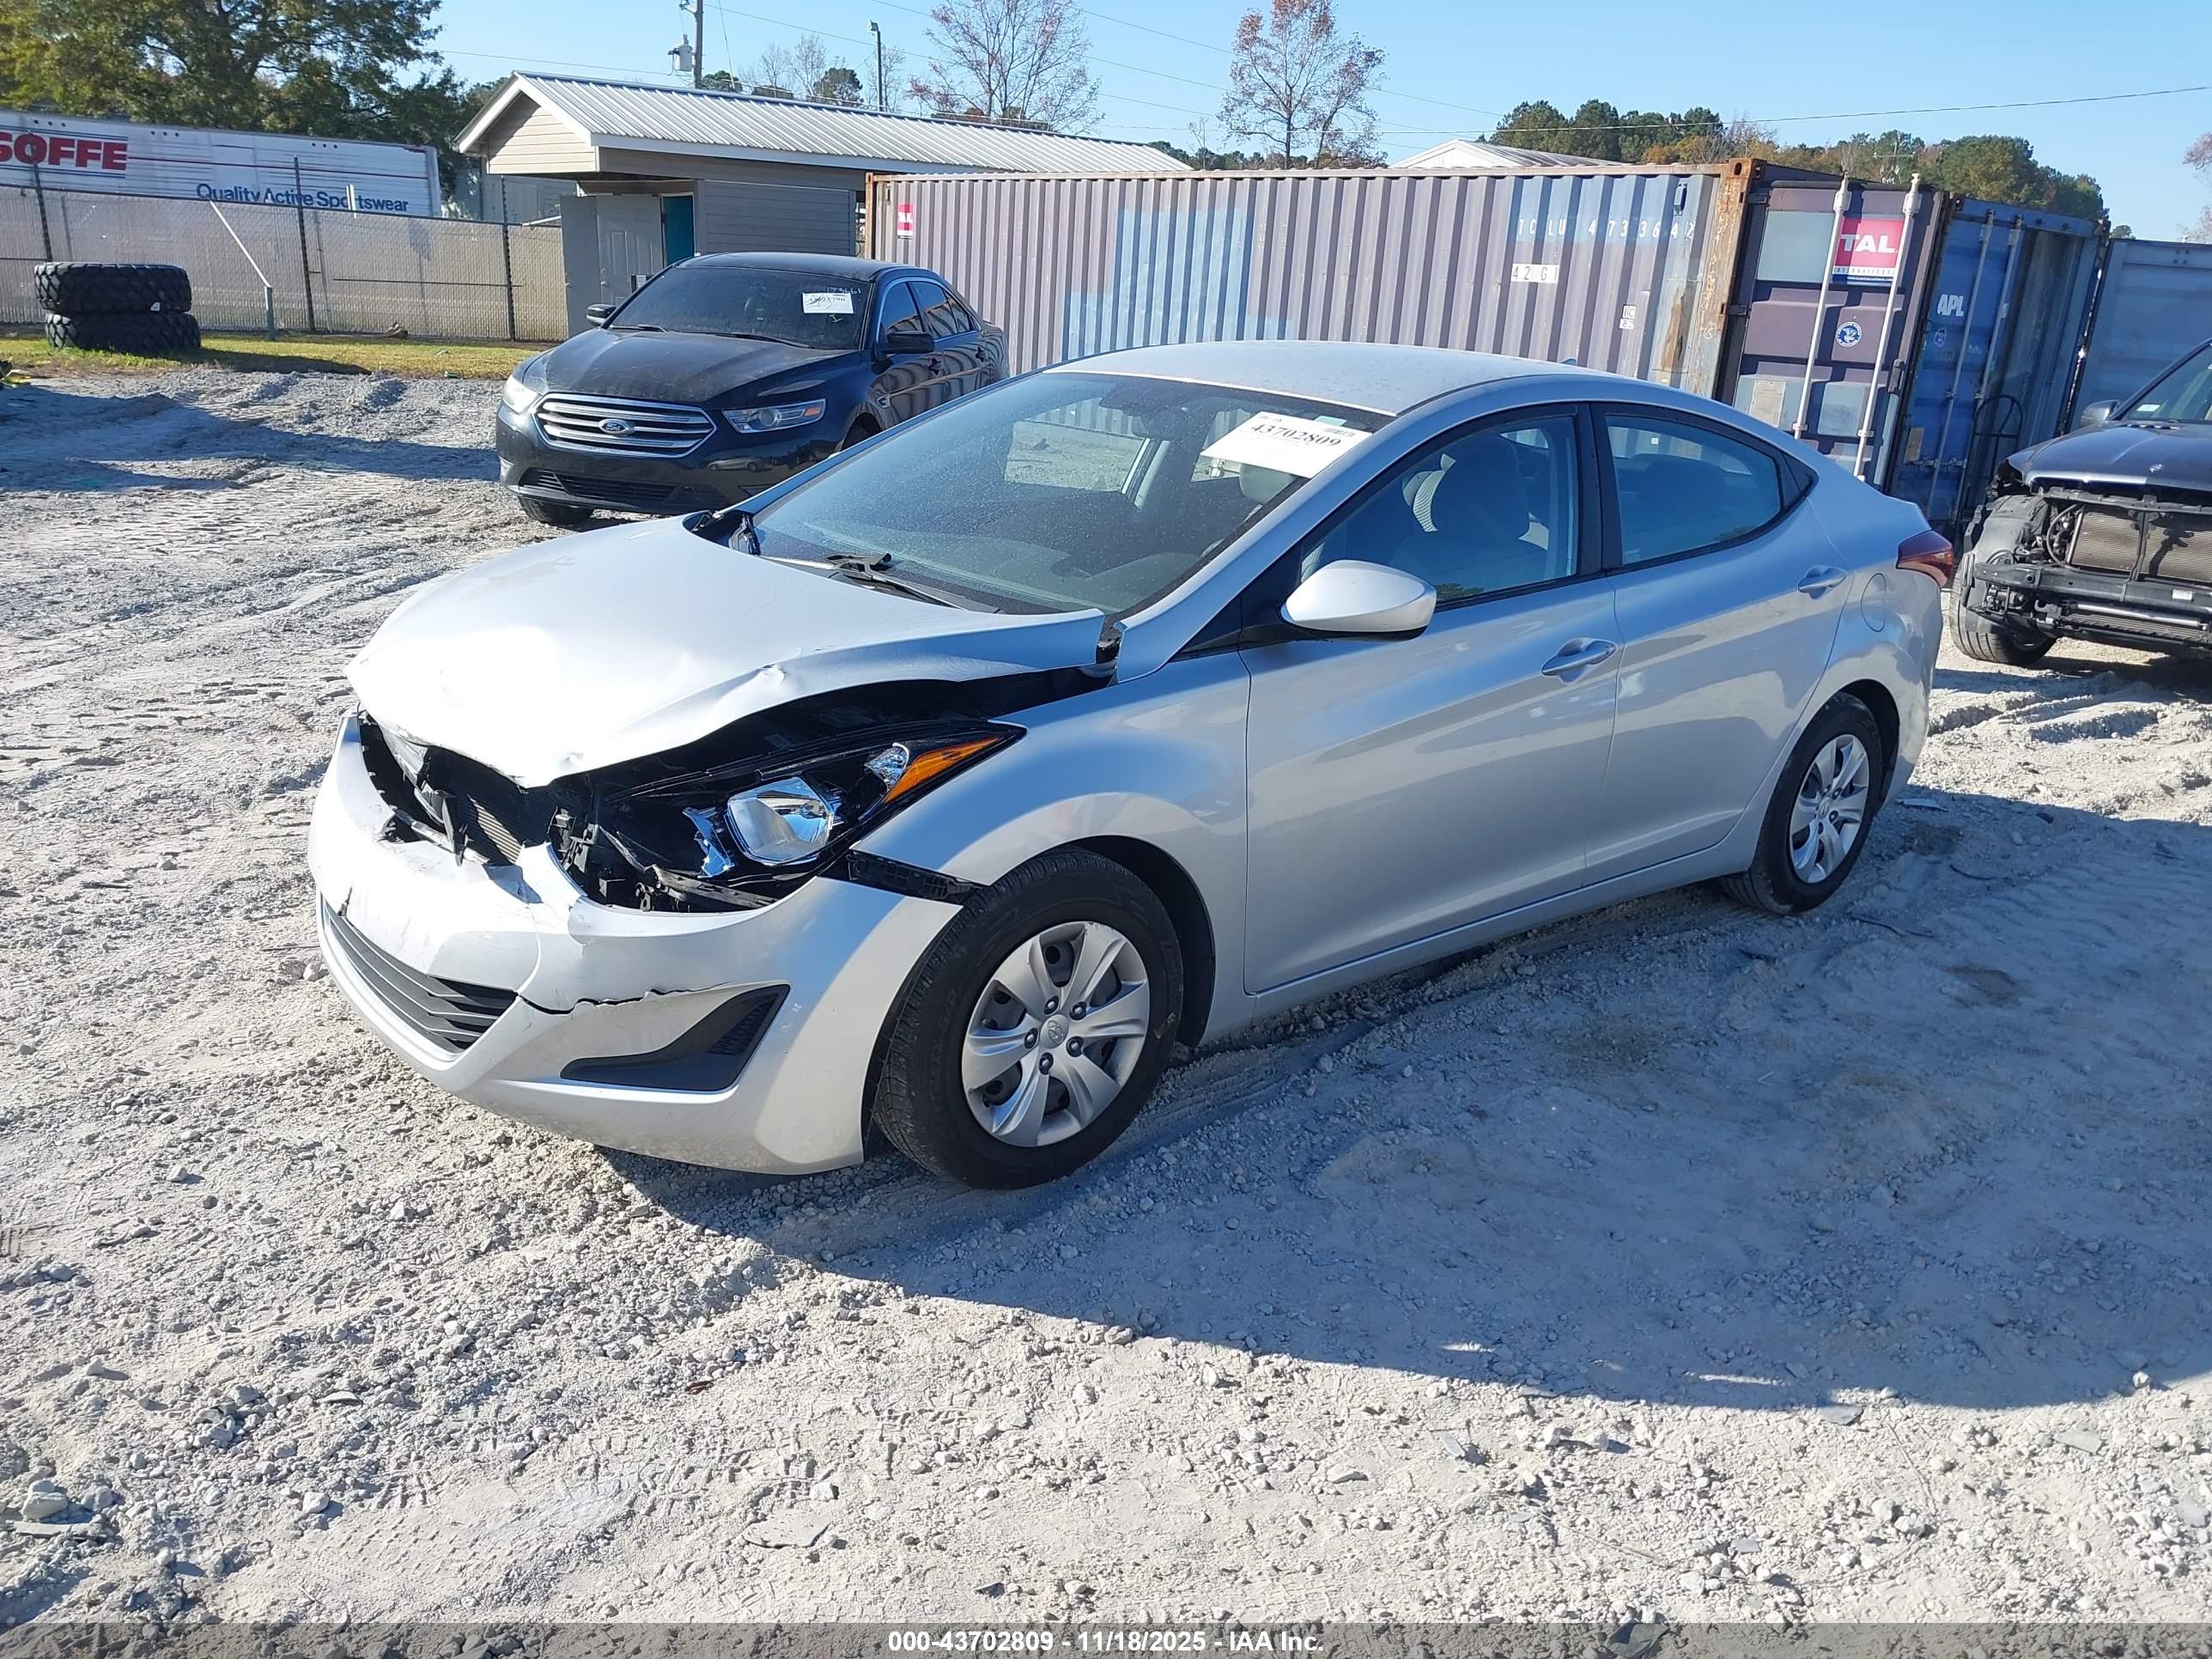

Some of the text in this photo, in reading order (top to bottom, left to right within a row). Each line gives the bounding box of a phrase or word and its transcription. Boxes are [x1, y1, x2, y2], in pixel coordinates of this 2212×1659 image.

[197, 183, 409, 212] Quality Active Spotswear
[1936, 294, 1964, 317] APL
[1251, 423, 1341, 446] 43702809
